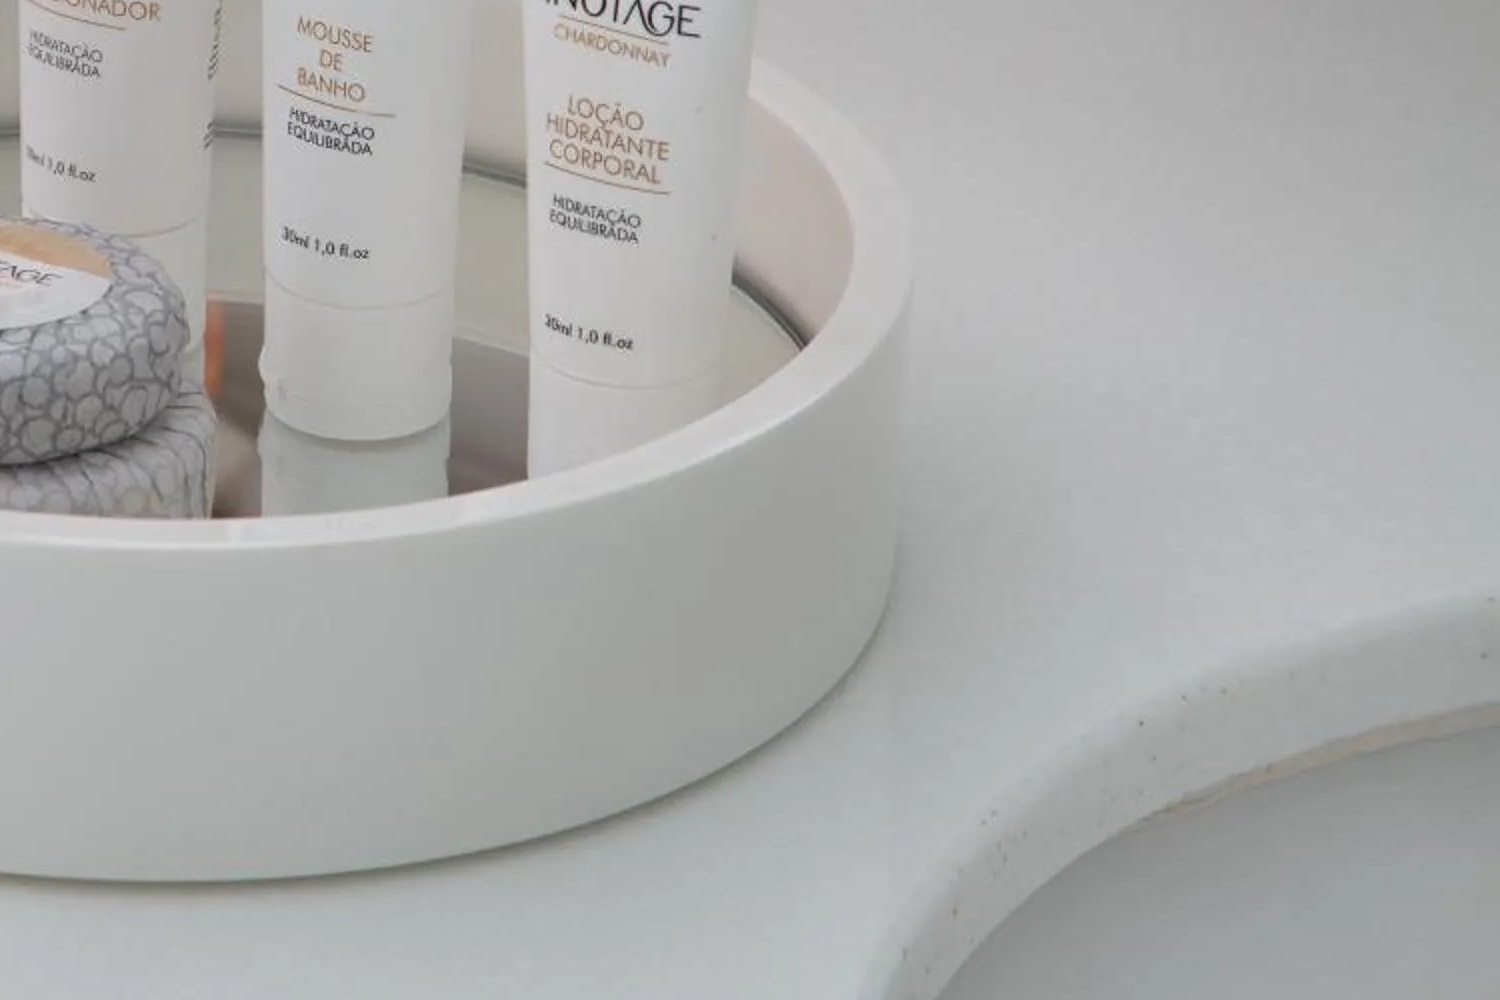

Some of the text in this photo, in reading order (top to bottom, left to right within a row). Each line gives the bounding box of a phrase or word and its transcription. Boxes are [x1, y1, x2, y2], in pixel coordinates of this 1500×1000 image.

[297, 15, 374, 53] MOUSSE
[554, 22, 671, 68] CHARDONNAY
[319, 48, 343, 72] DE
[296, 67, 365, 102] BANHO
[289, 107, 375, 141] HIDRATAÇÃO
[567, 95, 644, 131] LOÇÃO
[287, 121, 373, 156] EQUILIBRADA
[546, 112, 670, 161] HIDRATANTE
[549, 138, 661, 185] CORPORAL
[549, 210, 639, 244] EQUILIBRADA
[553, 193, 641, 229] HIDRATAÇÃO
[314, 238, 335, 256] 1,0
[577, 327, 599, 344] 1,0
